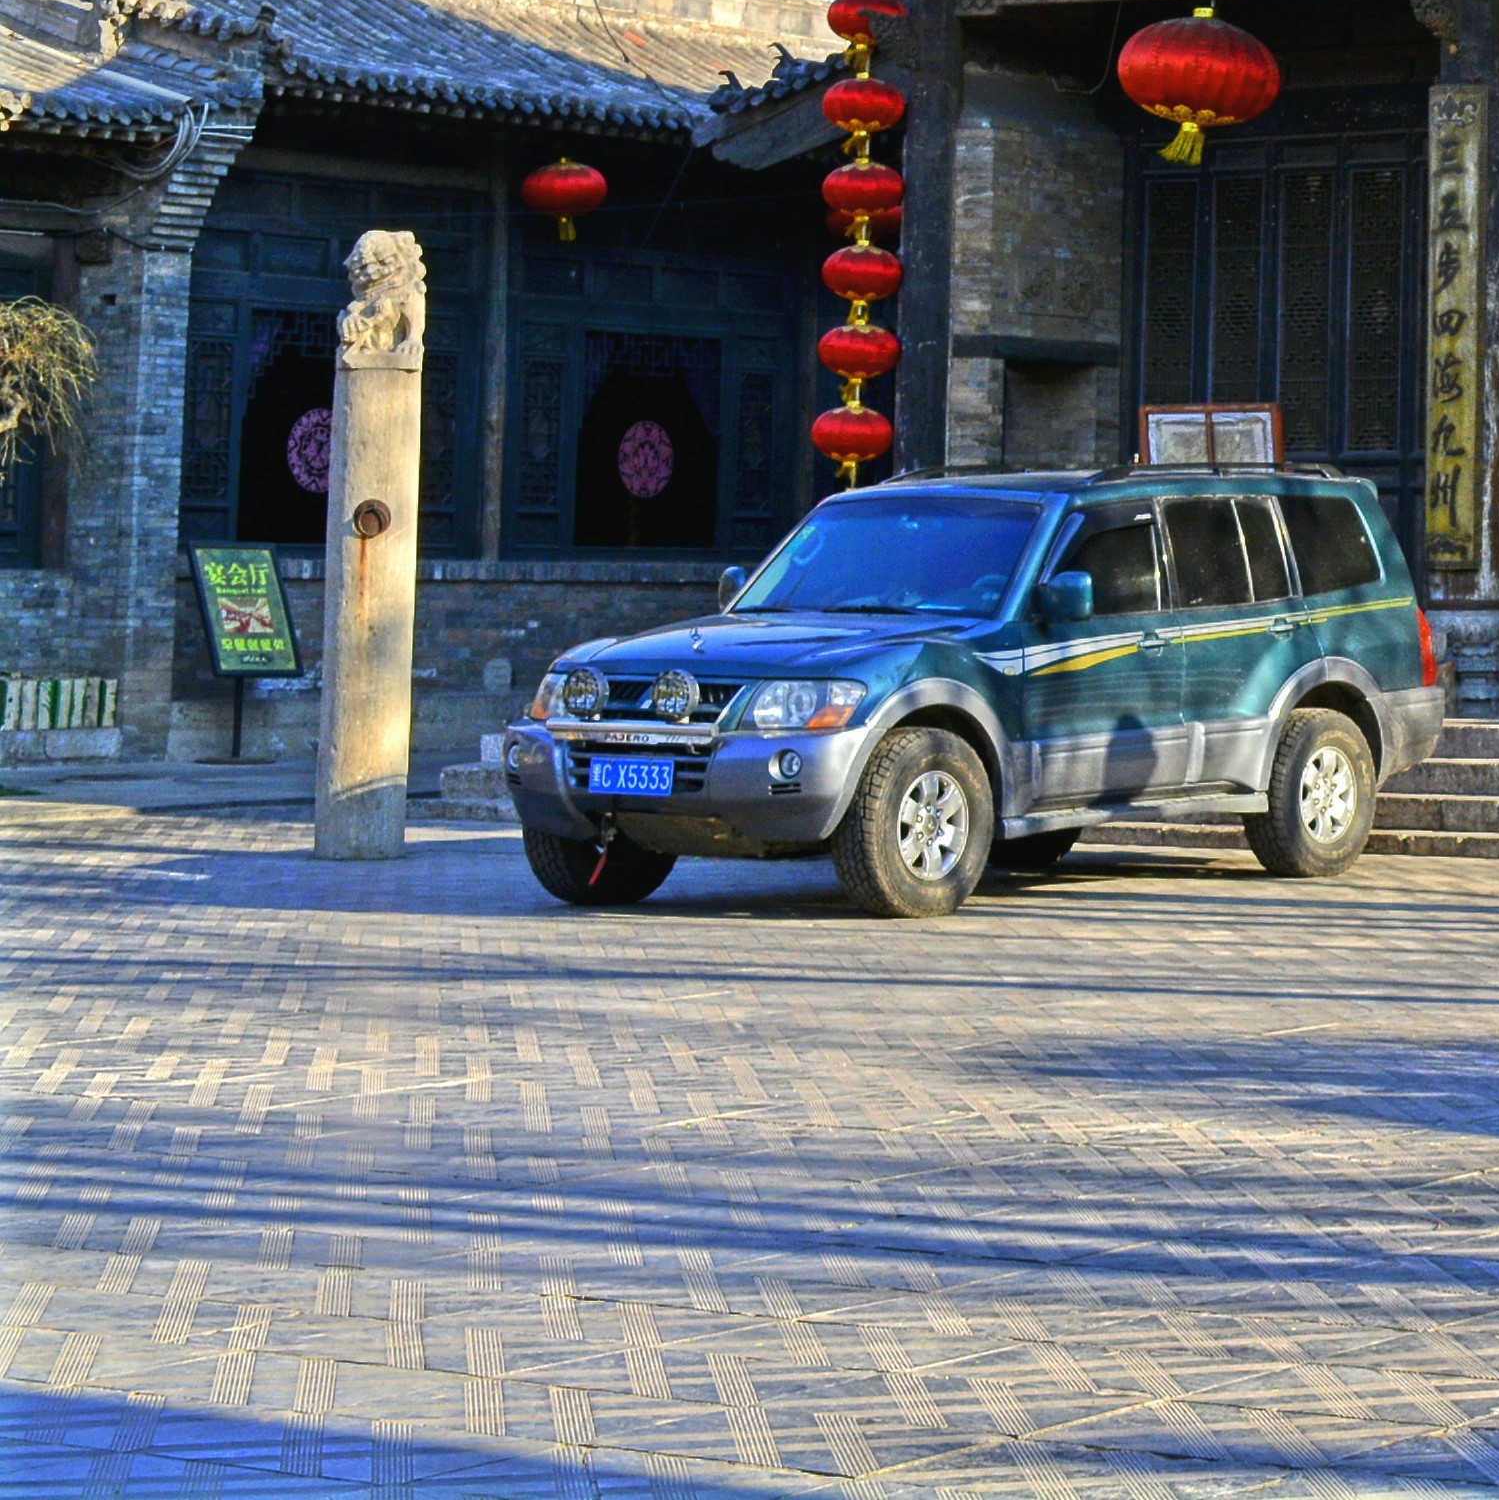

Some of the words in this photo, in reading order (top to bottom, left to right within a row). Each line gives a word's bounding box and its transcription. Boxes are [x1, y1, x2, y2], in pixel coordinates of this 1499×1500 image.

[204, 562, 269, 586] 宴会厅
[604, 733, 650, 743] PAJERO
